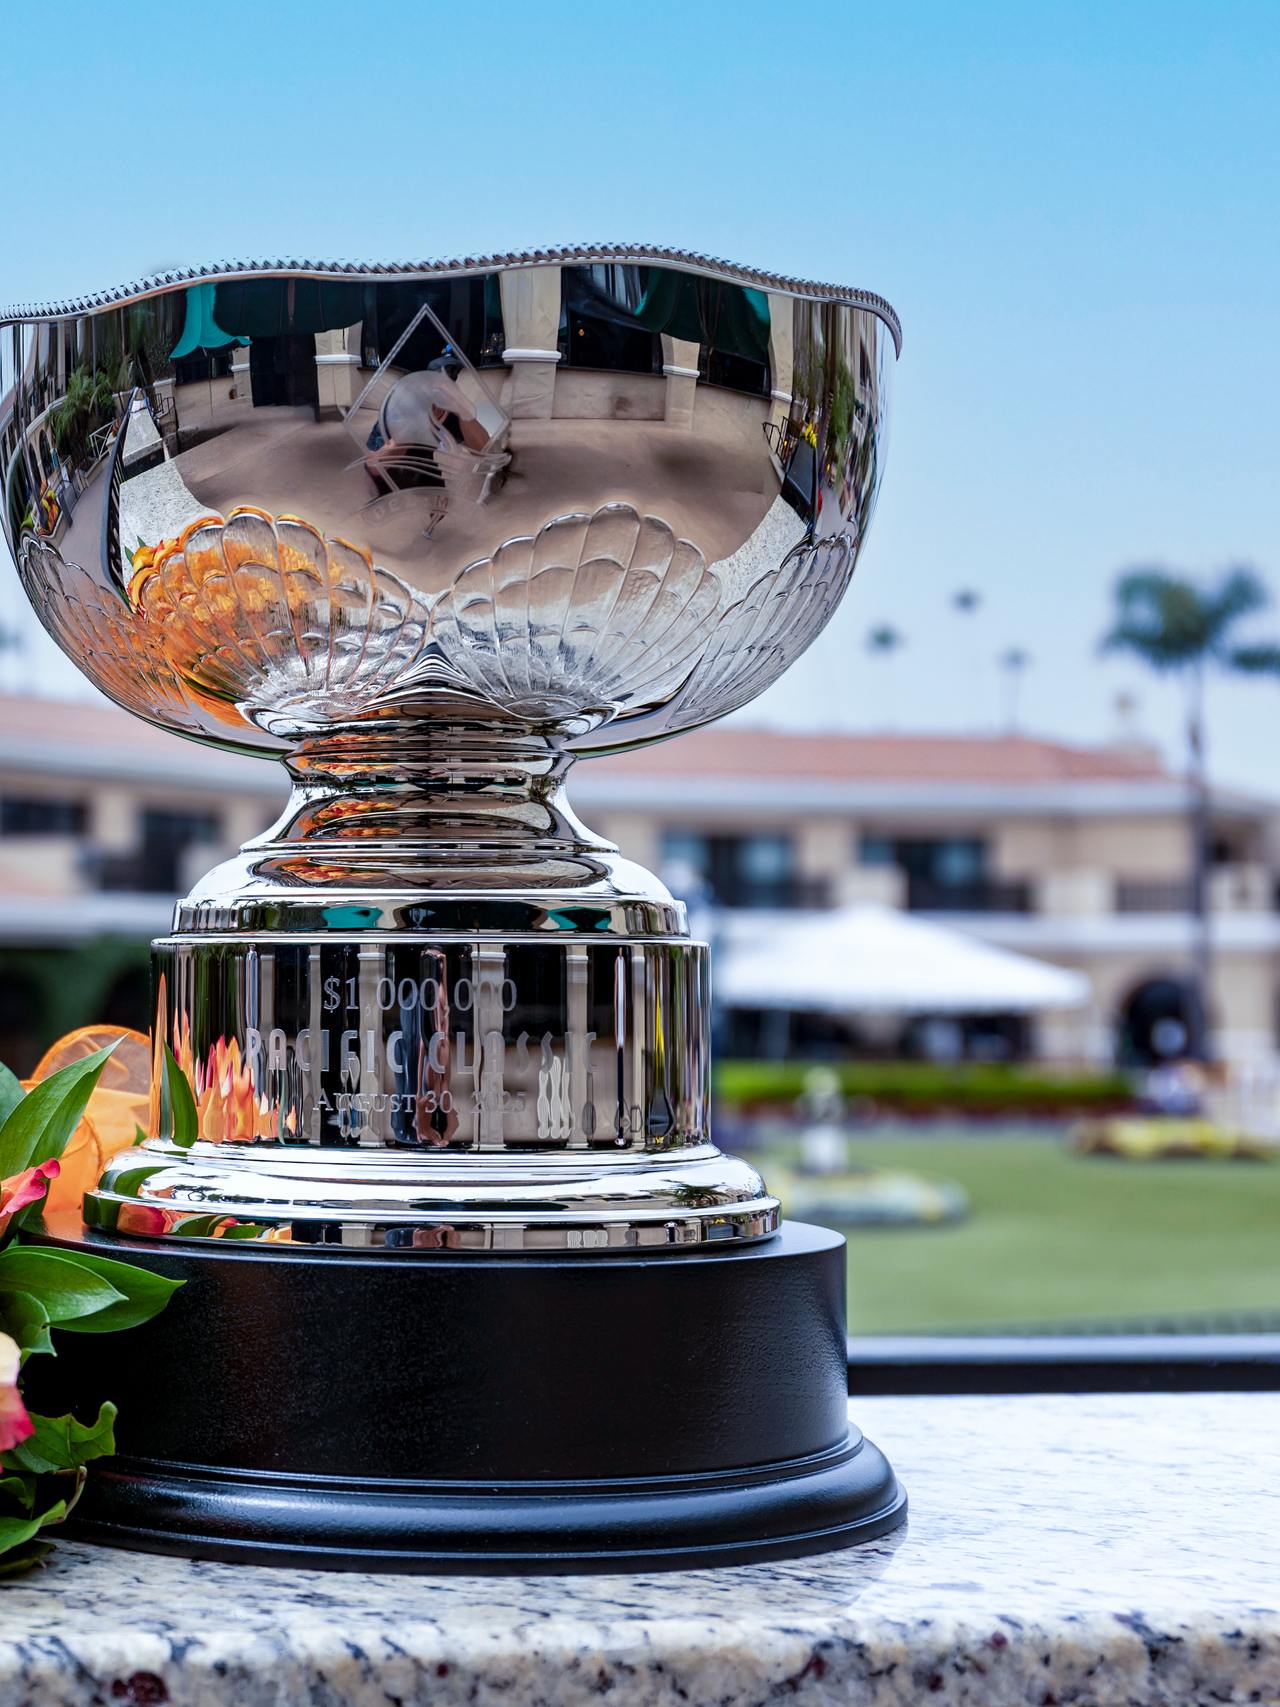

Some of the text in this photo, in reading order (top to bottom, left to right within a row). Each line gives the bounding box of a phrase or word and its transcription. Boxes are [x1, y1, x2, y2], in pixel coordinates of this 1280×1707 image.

[323, 976, 518, 1017] $1,000,000
[246, 1029, 597, 1074] PACIFIC CLASSIC
[313, 1089, 416, 1113] AUGUST
